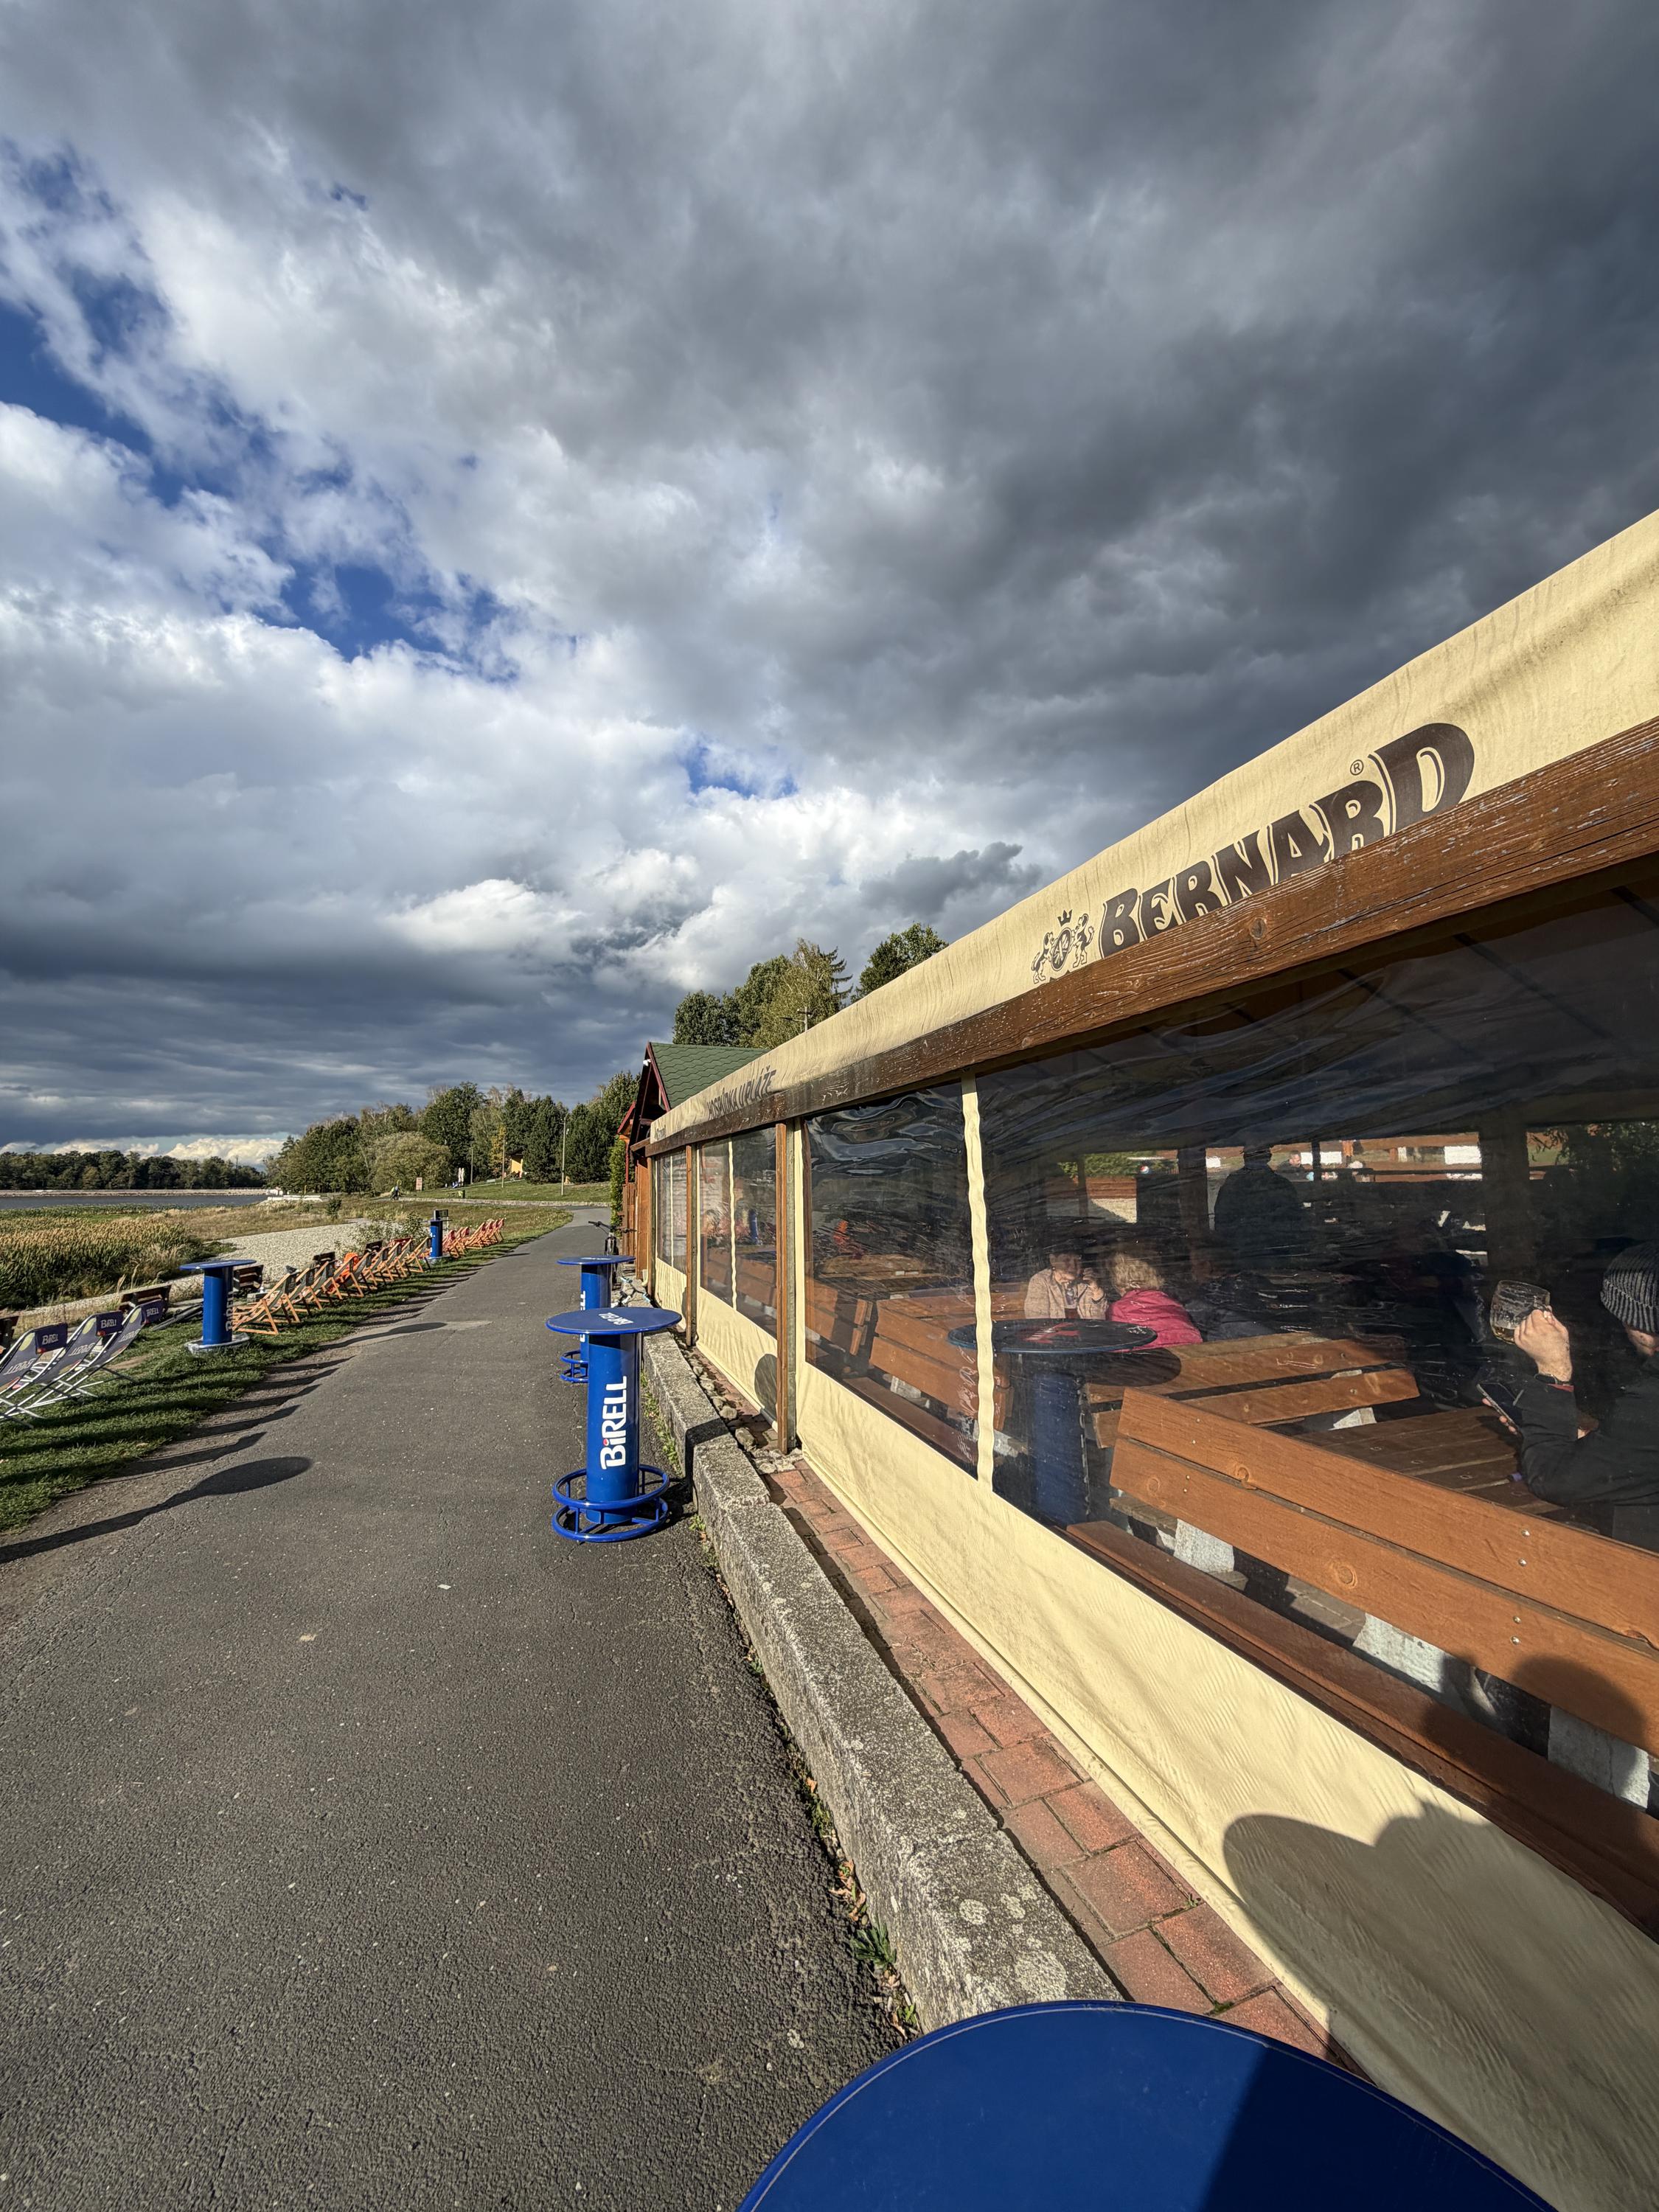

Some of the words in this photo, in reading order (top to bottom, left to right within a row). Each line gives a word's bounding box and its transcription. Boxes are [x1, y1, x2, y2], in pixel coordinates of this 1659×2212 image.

[1099, 723, 1475, 959] BERNARD
[739, 1082, 746, 1107] U
[745, 1065, 777, 1106] PLÁŽE
[599, 1375, 627, 1470] BiRELL
